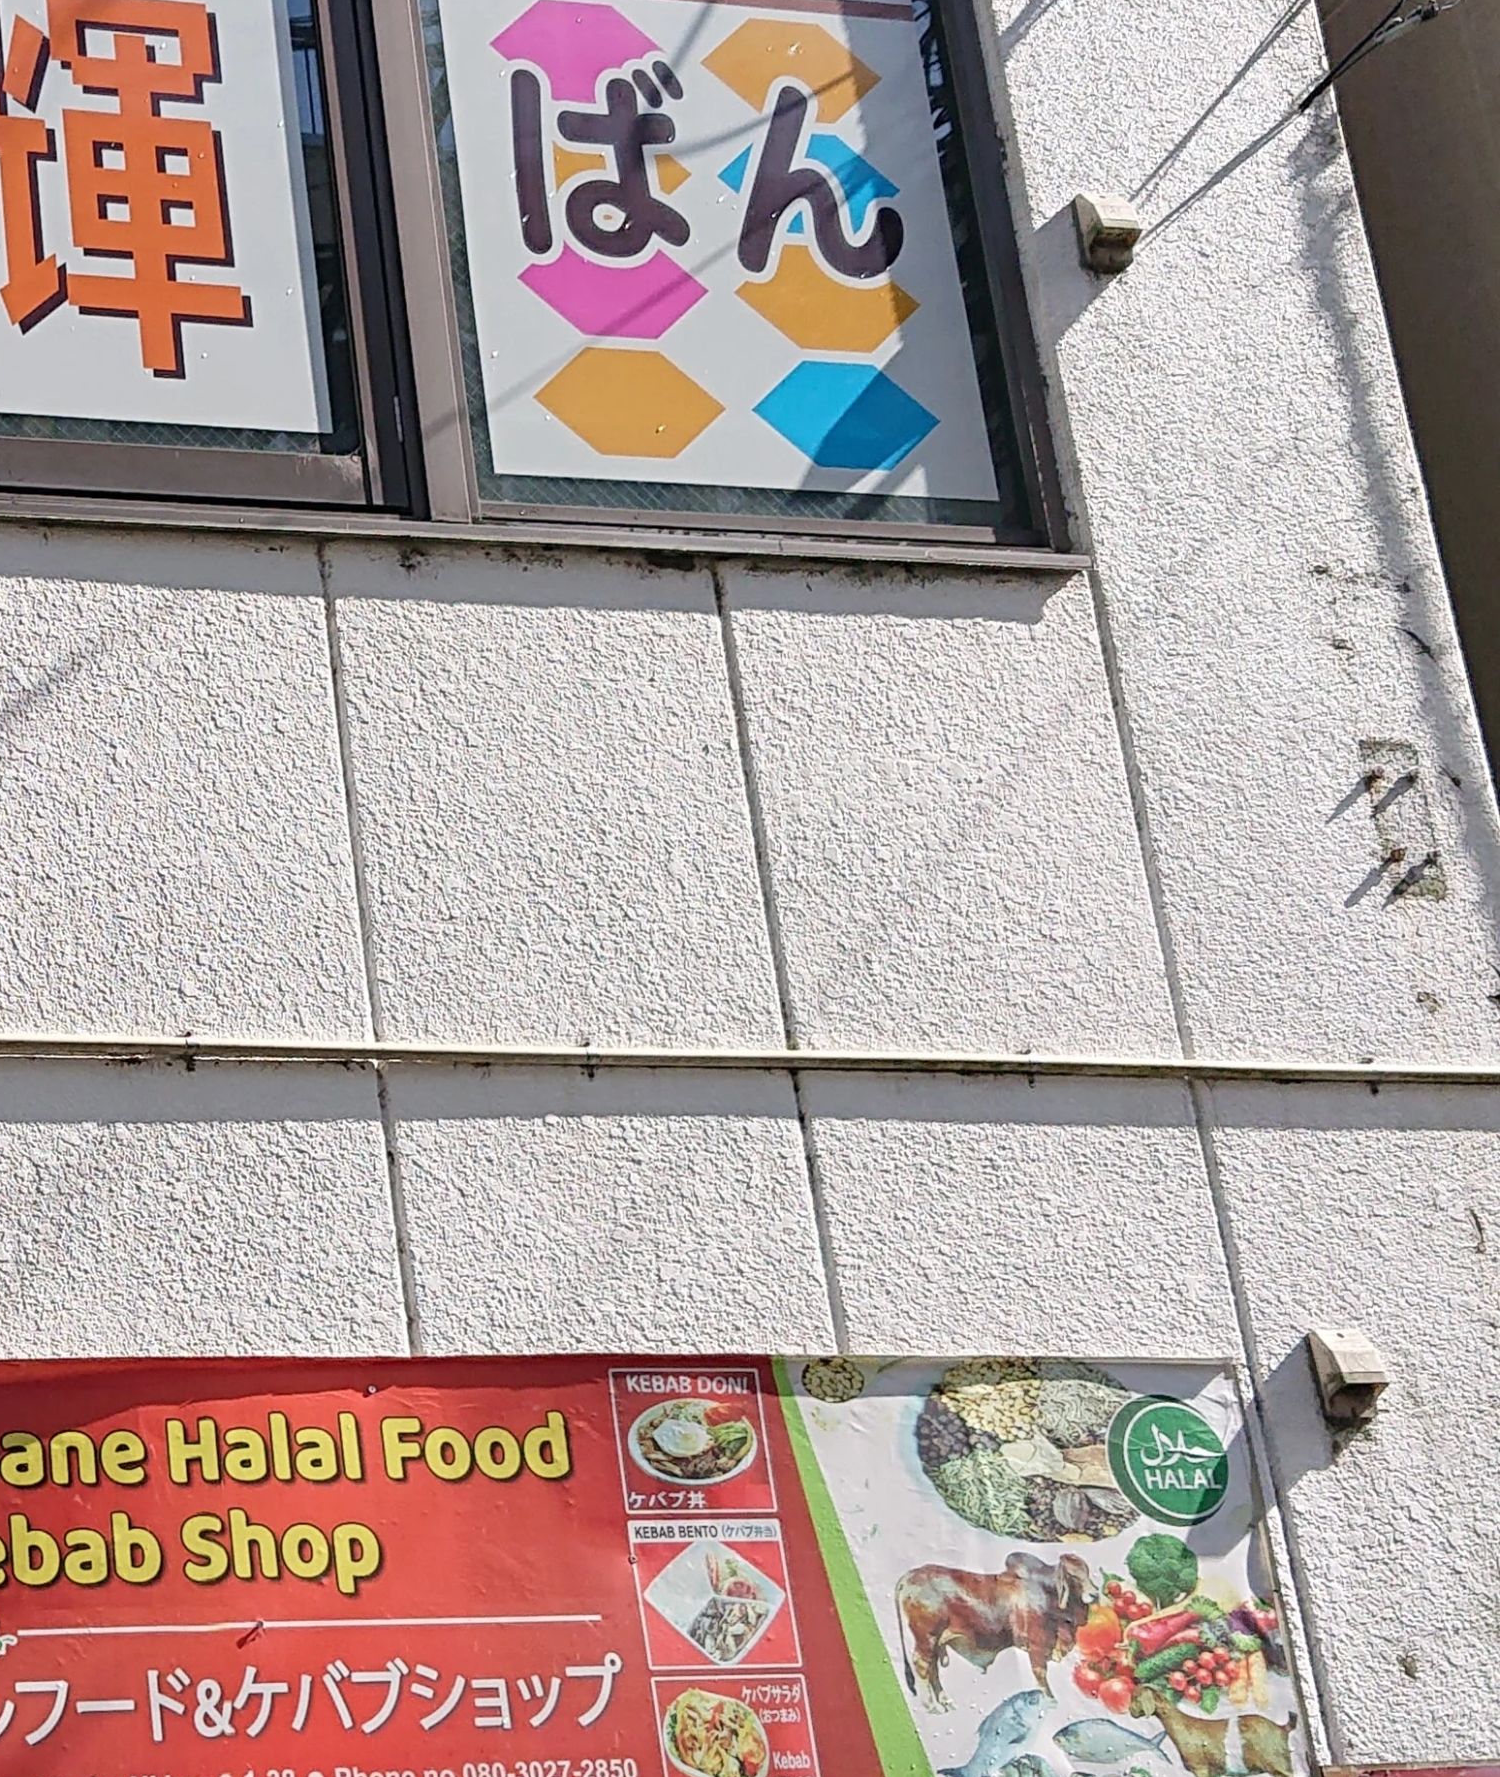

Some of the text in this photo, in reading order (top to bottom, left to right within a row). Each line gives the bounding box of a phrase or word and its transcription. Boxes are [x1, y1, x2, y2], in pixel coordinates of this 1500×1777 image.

[510, 59, 903, 279] ばん
[626, 1374, 749, 1395] KEBAB DON!
[166, 1412, 362, 1484] Halal
[381, 1410, 571, 1482] Food
[1138, 1422, 1226, 1468] حلال
[1143, 1467, 1223, 1492] HALAL
[628, 1490, 708, 1509] ケバブ丼
[634, 1525, 675, 1540] KEBAB
[678, 1524, 719, 1539] BENTO
[181, 1508, 382, 1595] Shop
[772, 1750, 811, 1770] Kebab
